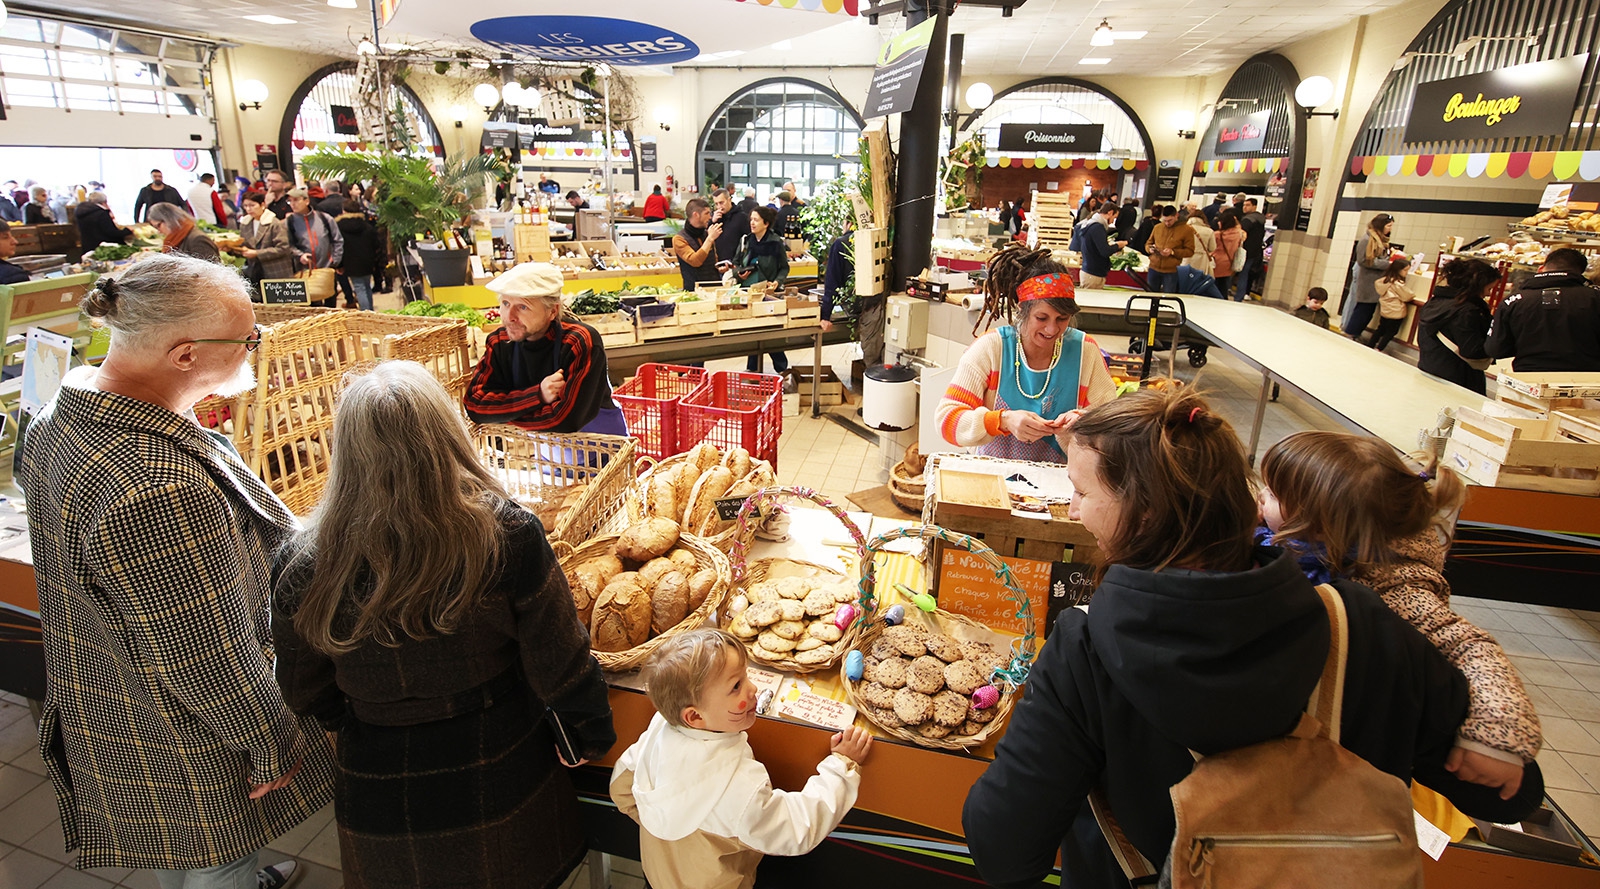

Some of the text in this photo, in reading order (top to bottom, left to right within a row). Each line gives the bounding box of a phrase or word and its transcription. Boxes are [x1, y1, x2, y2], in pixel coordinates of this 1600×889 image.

[538, 32, 584, 44] LES
[1443, 92, 1521, 126] Boulanger
[1024, 130, 1076, 144] Poissonnier
[960, 556, 1031, 575] Nouvuté
[946, 570, 985, 583] Retrouvez
